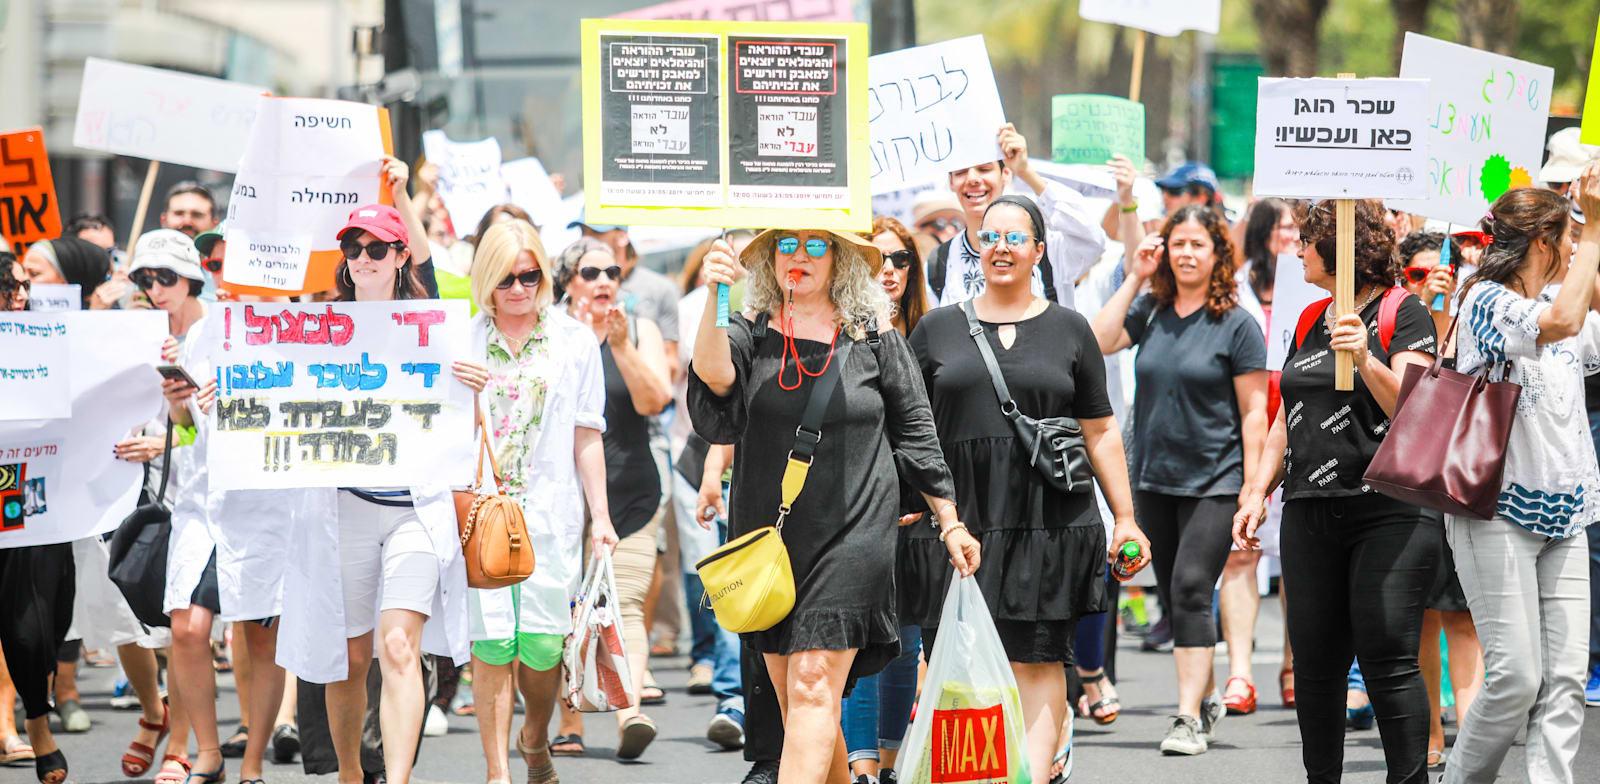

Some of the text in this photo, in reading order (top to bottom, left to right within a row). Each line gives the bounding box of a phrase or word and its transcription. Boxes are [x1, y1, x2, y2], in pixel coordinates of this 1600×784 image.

[621, 46, 696, 57] עובדי ההוראה
[748, 45, 824, 56] עובדי ההוראה
[612, 57, 705, 68] והגימלאים יוצאים
[739, 56, 833, 68] והגימלאים יוצאים
[617, 69, 701, 81] למאבק ודורשים
[743, 69, 829, 80] למאבק ודורשים
[674, 82, 692, 91] את
[802, 82, 820, 91] את
[1294, 98, 1396, 116] שכר הוגן
[632, 110, 688, 120] עובדי הוראה
[759, 111, 816, 121] עובדי הוראה
[295, 115, 352, 129] חשיפה
[650, 124, 668, 135] לא
[777, 125, 795, 137] לא
[1275, 126, 1412, 148] כאן ועכשיו!
[633, 139, 687, 151] עבדי הוראה
[759, 140, 815, 154] עבדי הוראה
[291, 187, 359, 204] מתחילה
[249, 243, 301, 254] הלבורנטים
[249, 257, 298, 270] אומרים לא
[55, 322, 67, 336] בלי
[392, 309, 447, 347] די
[36, 364, 49, 378] בלי
[307, 352, 388, 391] לשכר
[1302, 359, 1322, 371] PARIS
[401, 362, 441, 388] די
[217, 397, 271, 431] ללא
[401, 403, 442, 430] די
[1331, 418, 1351, 434] PARIS
[7, 447, 20, 459] זה
[24, 444, 58, 458] מדעים
[1317, 471, 1338, 487] PARIS
[941, 714, 1000, 775] MAX
